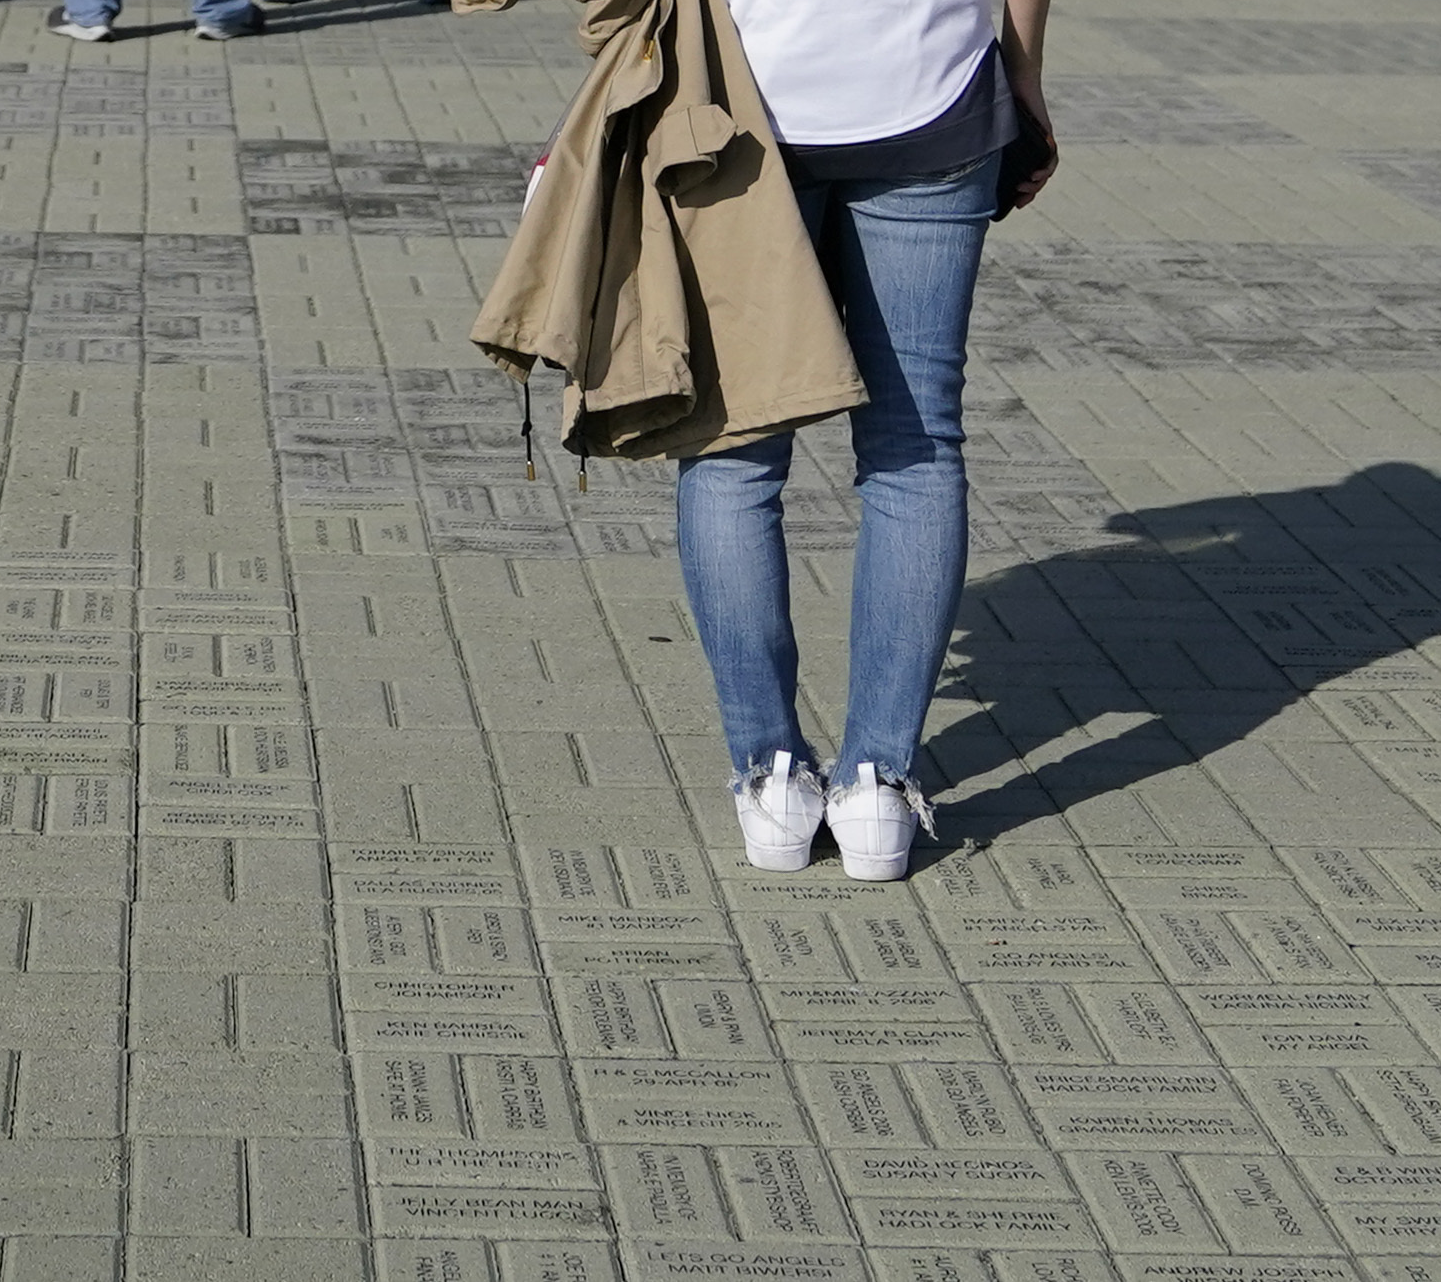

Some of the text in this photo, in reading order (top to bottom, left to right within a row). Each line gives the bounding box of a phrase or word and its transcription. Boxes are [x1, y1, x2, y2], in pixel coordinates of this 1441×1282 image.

[1149, 1085, 1217, 1093] FAMILY
[863, 1170, 940, 1179] SUSAN
[534, 1199, 583, 1209] MAN
[879, 1209, 938, 1218] RYAN
[1355, 1216, 1387, 1225] MY
[995, 1221, 1071, 1230] FAMILY
[711, 1253, 745, 1263] GO
[752, 1254, 846, 1266] ANGELS
